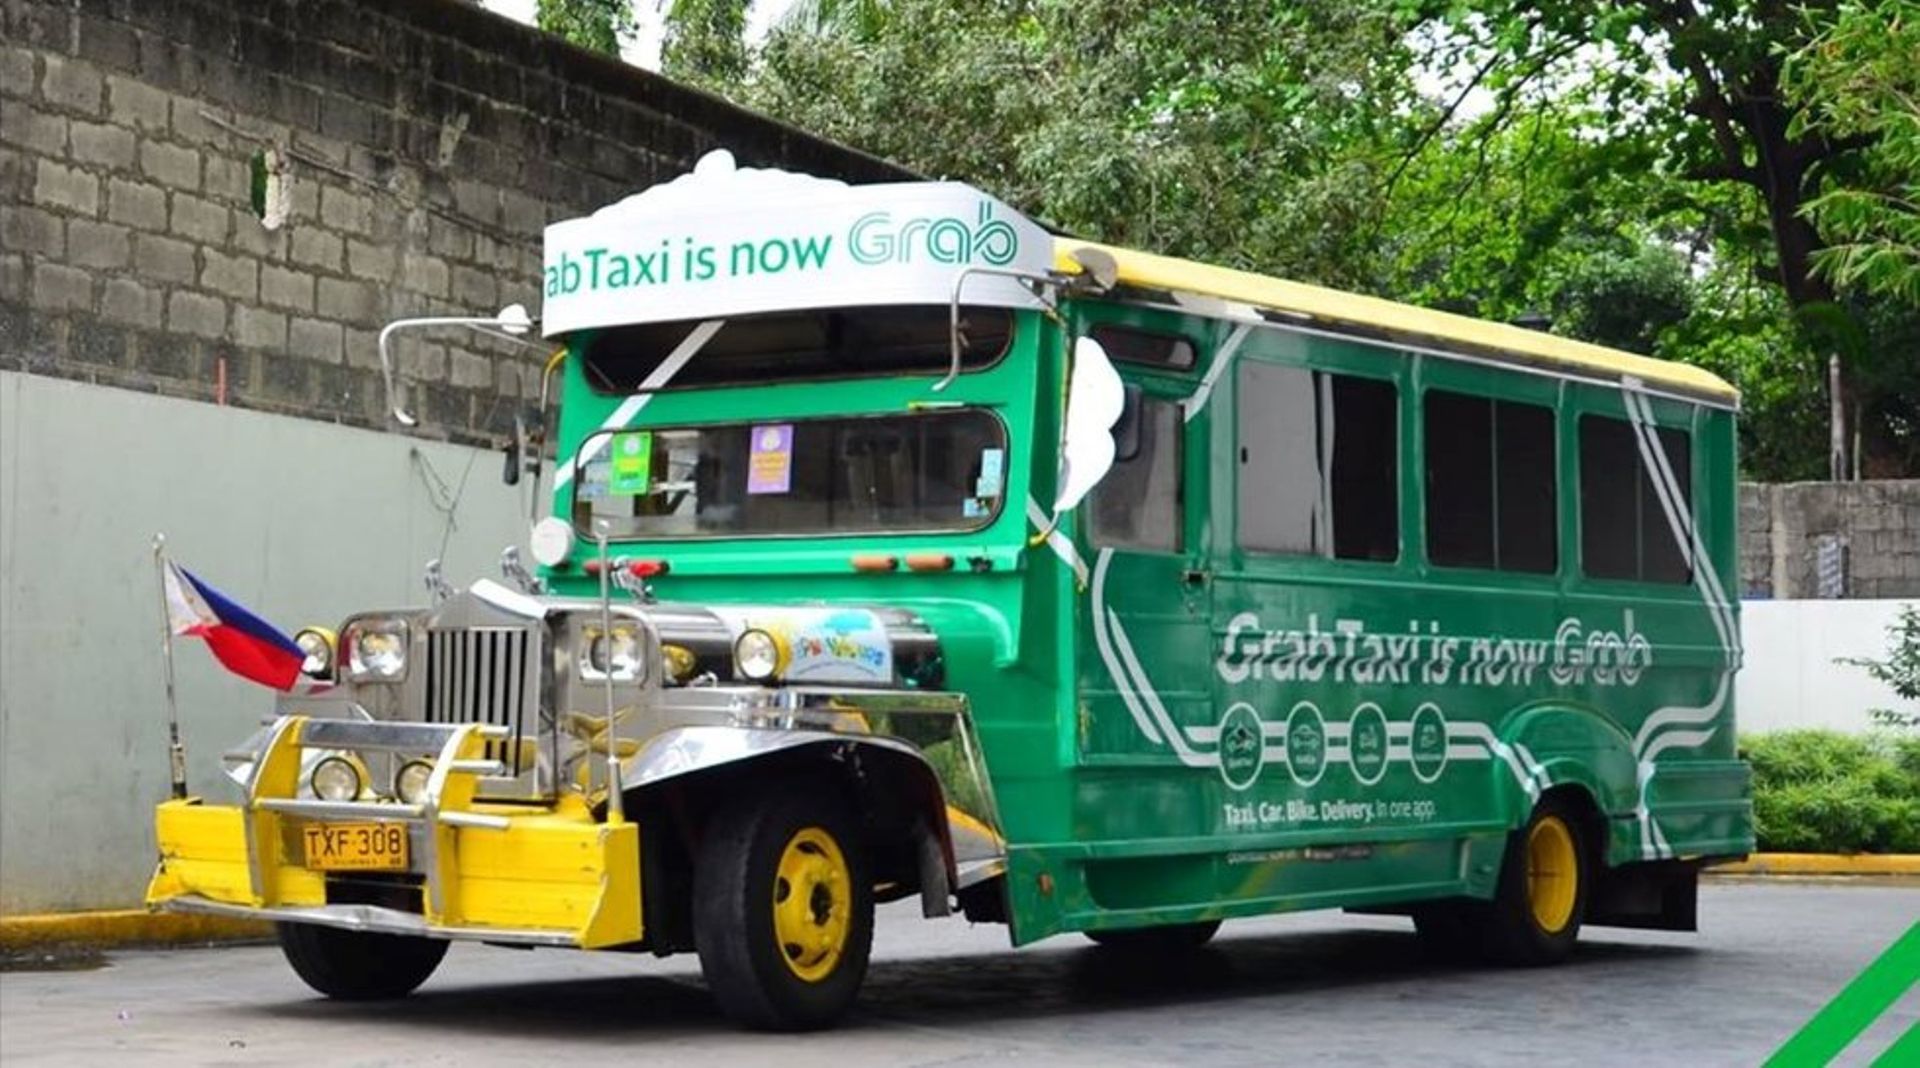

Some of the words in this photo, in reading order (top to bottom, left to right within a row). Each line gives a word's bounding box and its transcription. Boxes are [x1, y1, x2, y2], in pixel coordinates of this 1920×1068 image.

[545, 238, 670, 297] abTaxi
[684, 236, 717, 281] is
[730, 233, 833, 277] now
[847, 201, 1018, 265] Grab
[1216, 612, 1420, 684] GrabTaxi
[1420, 619, 1460, 685] is
[1458, 637, 1549, 686] now
[1549, 608, 1652, 687] Grab
[1223, 802, 1258, 826] Taxi.
[1258, 801, 1286, 822] Car.
[1286, 798, 1320, 821] Bike.
[1389, 802, 1412, 817] one
